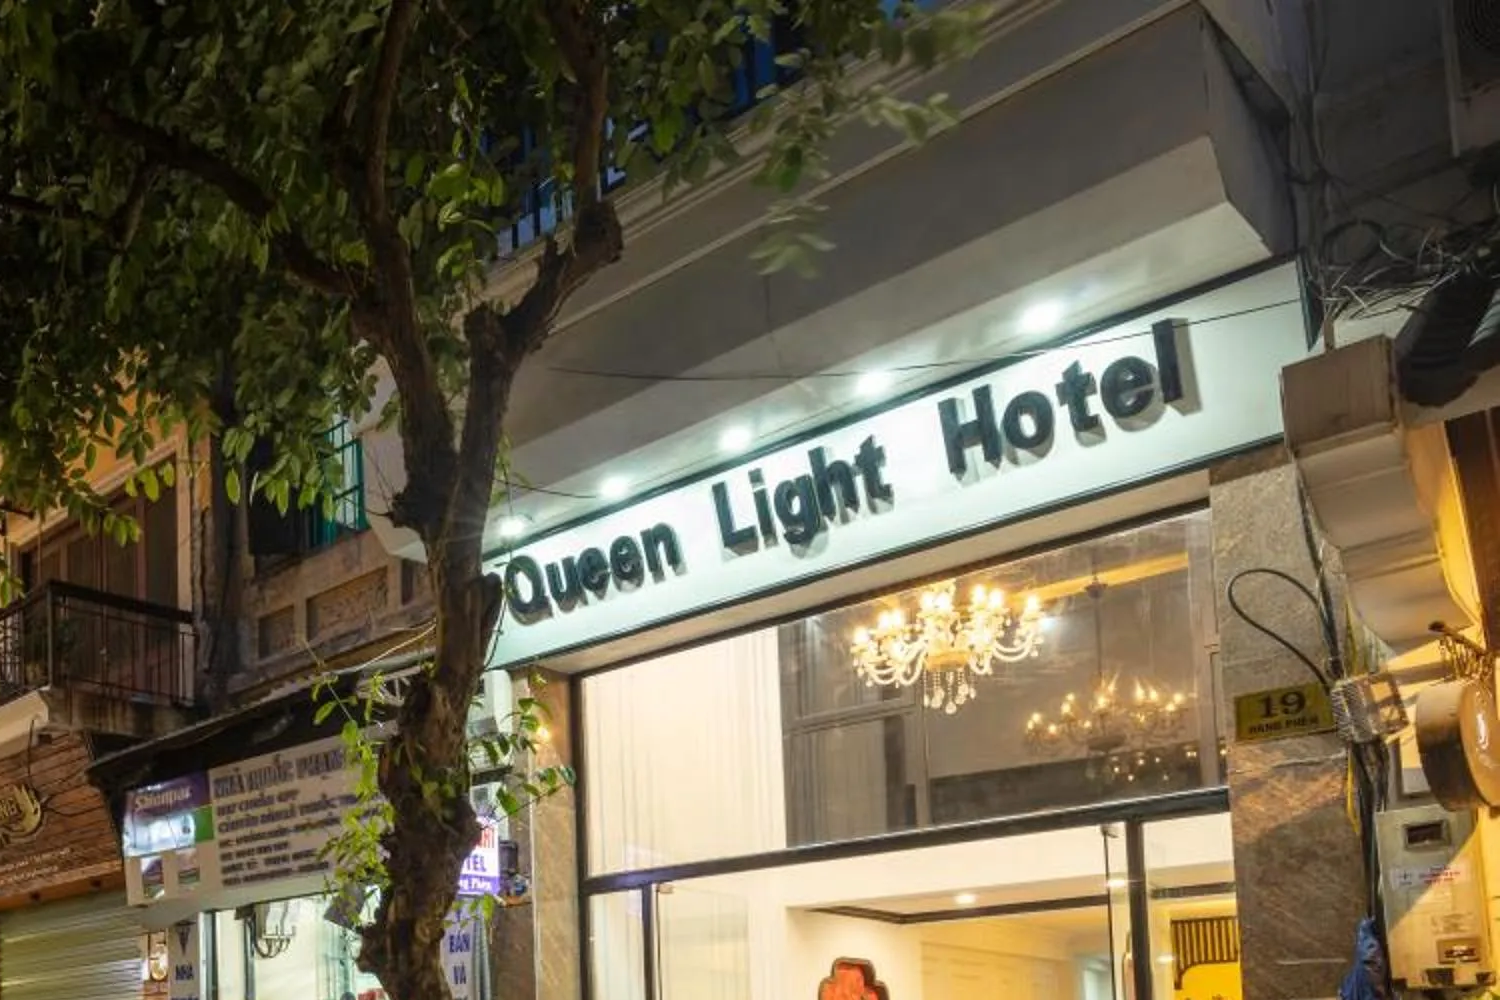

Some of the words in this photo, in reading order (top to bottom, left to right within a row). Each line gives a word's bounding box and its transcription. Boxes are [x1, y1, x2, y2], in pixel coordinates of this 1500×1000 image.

[504, 522, 682, 626] Queen
[711, 435, 891, 556] Light
[938, 318, 1196, 482] Hotel
[1260, 690, 1306, 718] 19
